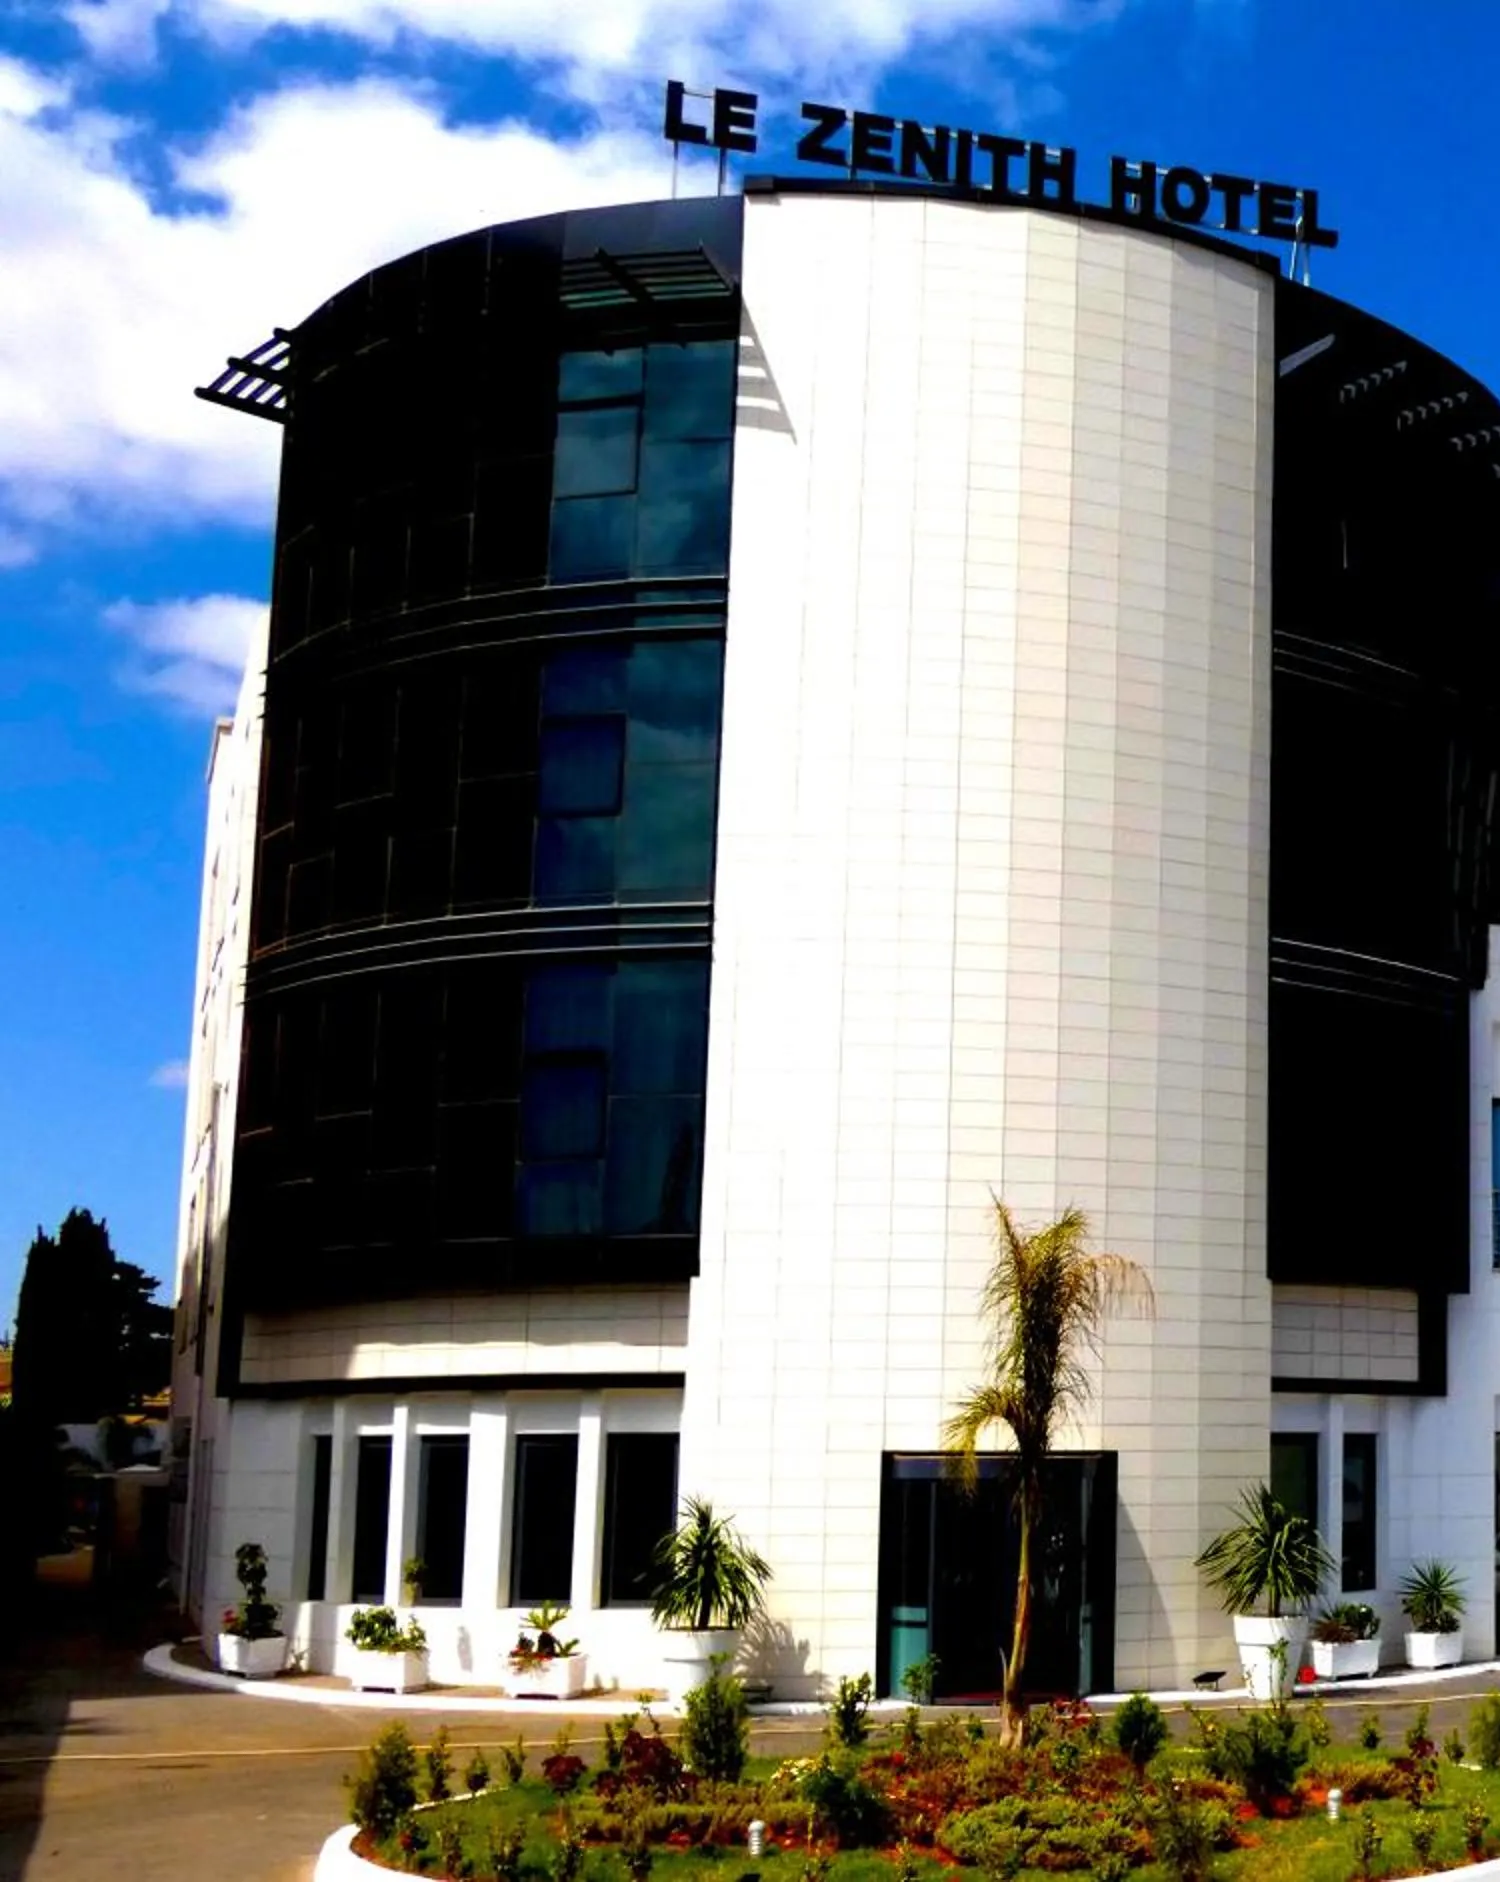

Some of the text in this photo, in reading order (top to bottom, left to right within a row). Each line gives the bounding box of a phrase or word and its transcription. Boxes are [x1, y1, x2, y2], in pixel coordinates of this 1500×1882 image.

[664, 79, 1339, 248] LE ZENITH HOTEL
